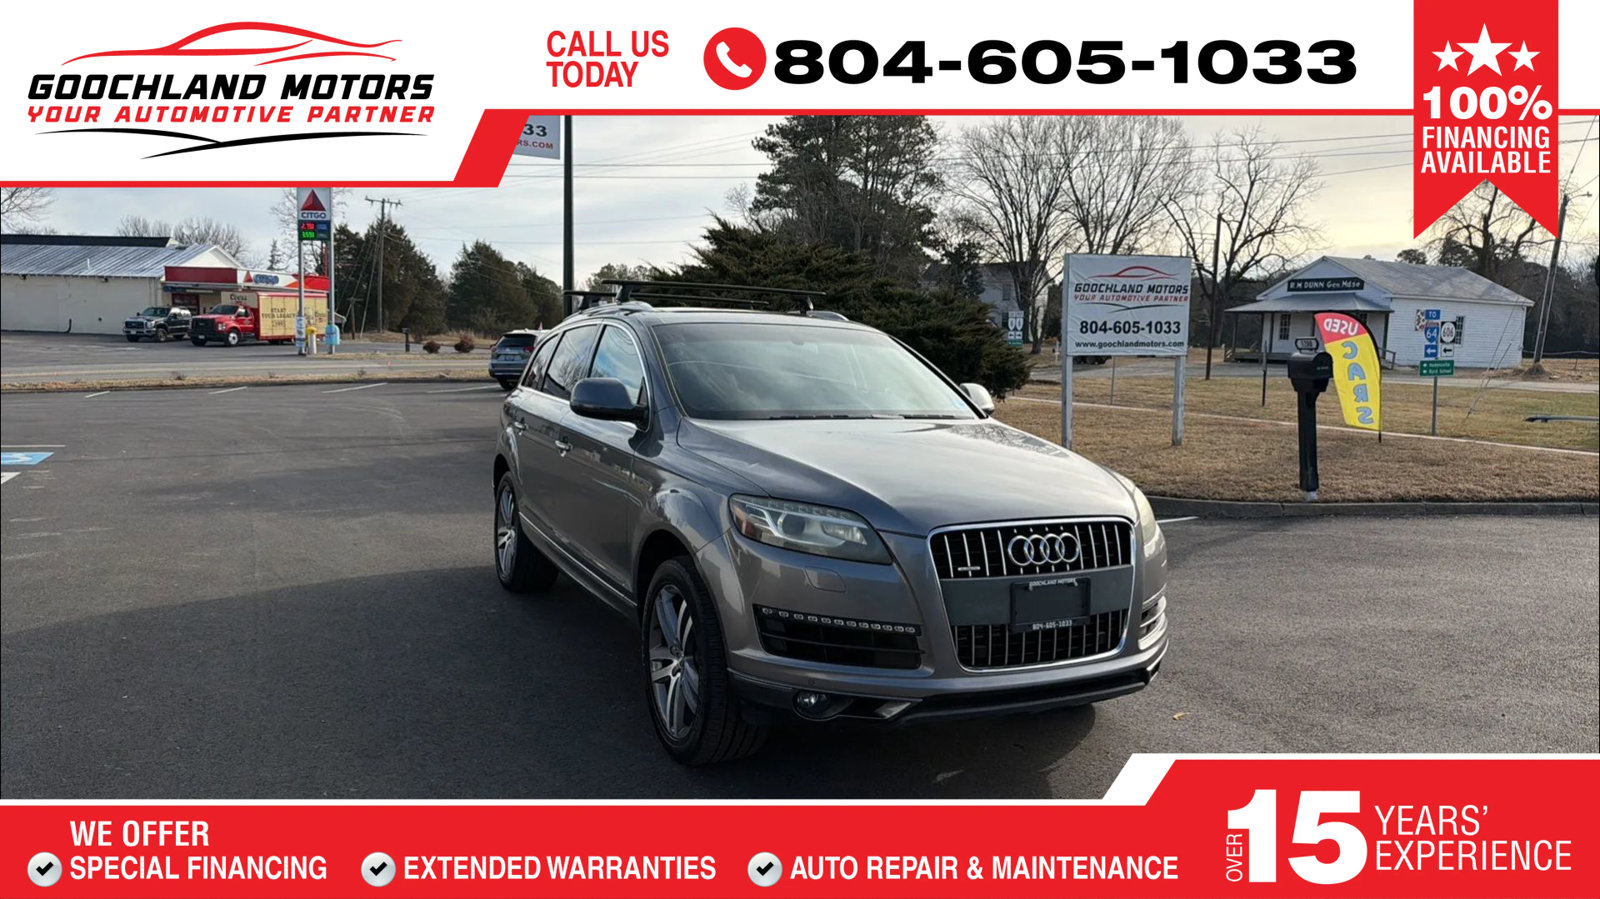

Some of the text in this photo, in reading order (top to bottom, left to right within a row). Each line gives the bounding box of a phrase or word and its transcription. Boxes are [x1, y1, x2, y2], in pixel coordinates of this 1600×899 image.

[1074, 283, 1189, 294] GOOCHLAND MOTORS
[1099, 294, 1151, 302] AUTOMOTIVE
[1080, 321, 1181, 334] 804-605-1033
[1442, 327, 1454, 337] 606
[1427, 328, 1437, 338] 64
[1075, 341, 1185, 349] www.goochlandmotors.com
[1032, 620, 1072, 630] 804-605-1033
